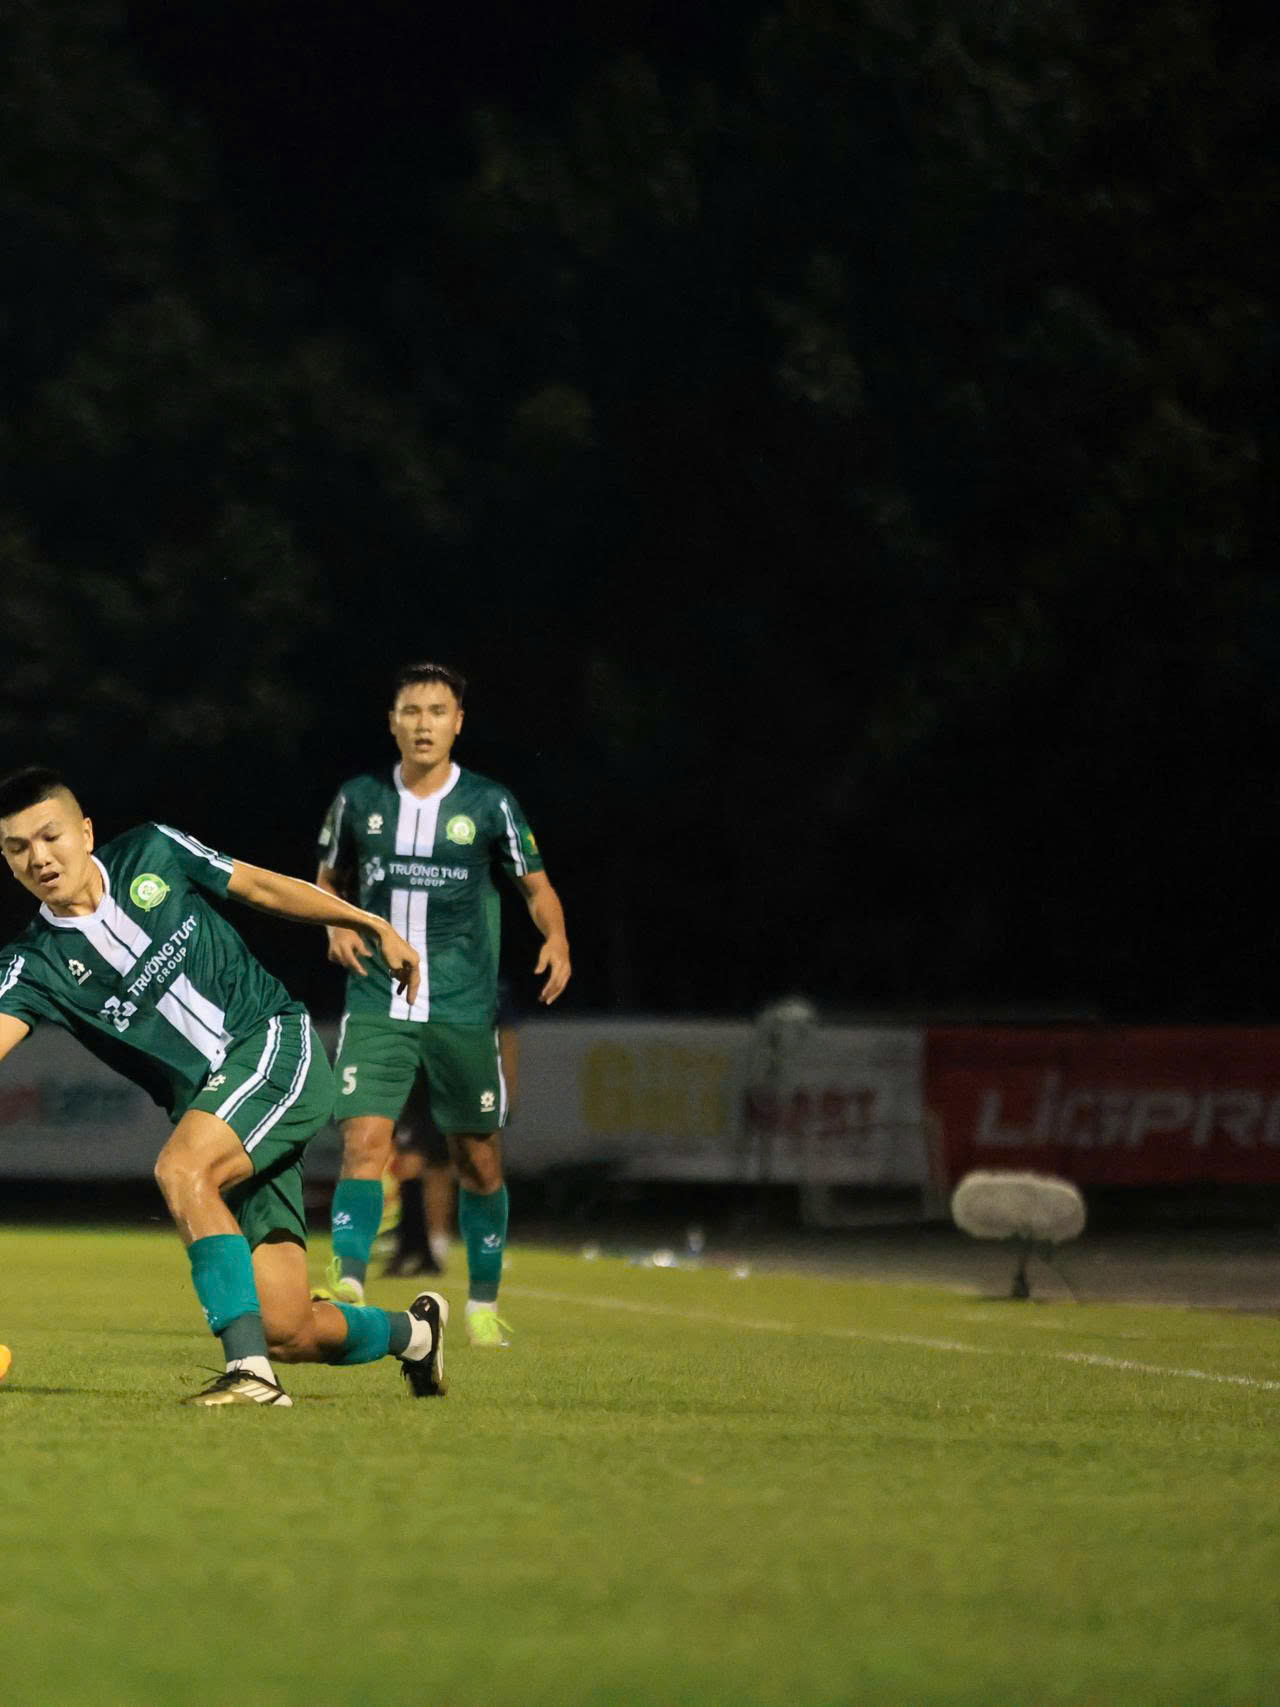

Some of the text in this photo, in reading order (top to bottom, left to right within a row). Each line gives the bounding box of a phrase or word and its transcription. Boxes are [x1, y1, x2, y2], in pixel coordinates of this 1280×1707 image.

[410, 877, 445, 887] GROUP
[156, 946, 187, 984] GROUP
[342, 1066, 358, 1096] 5
